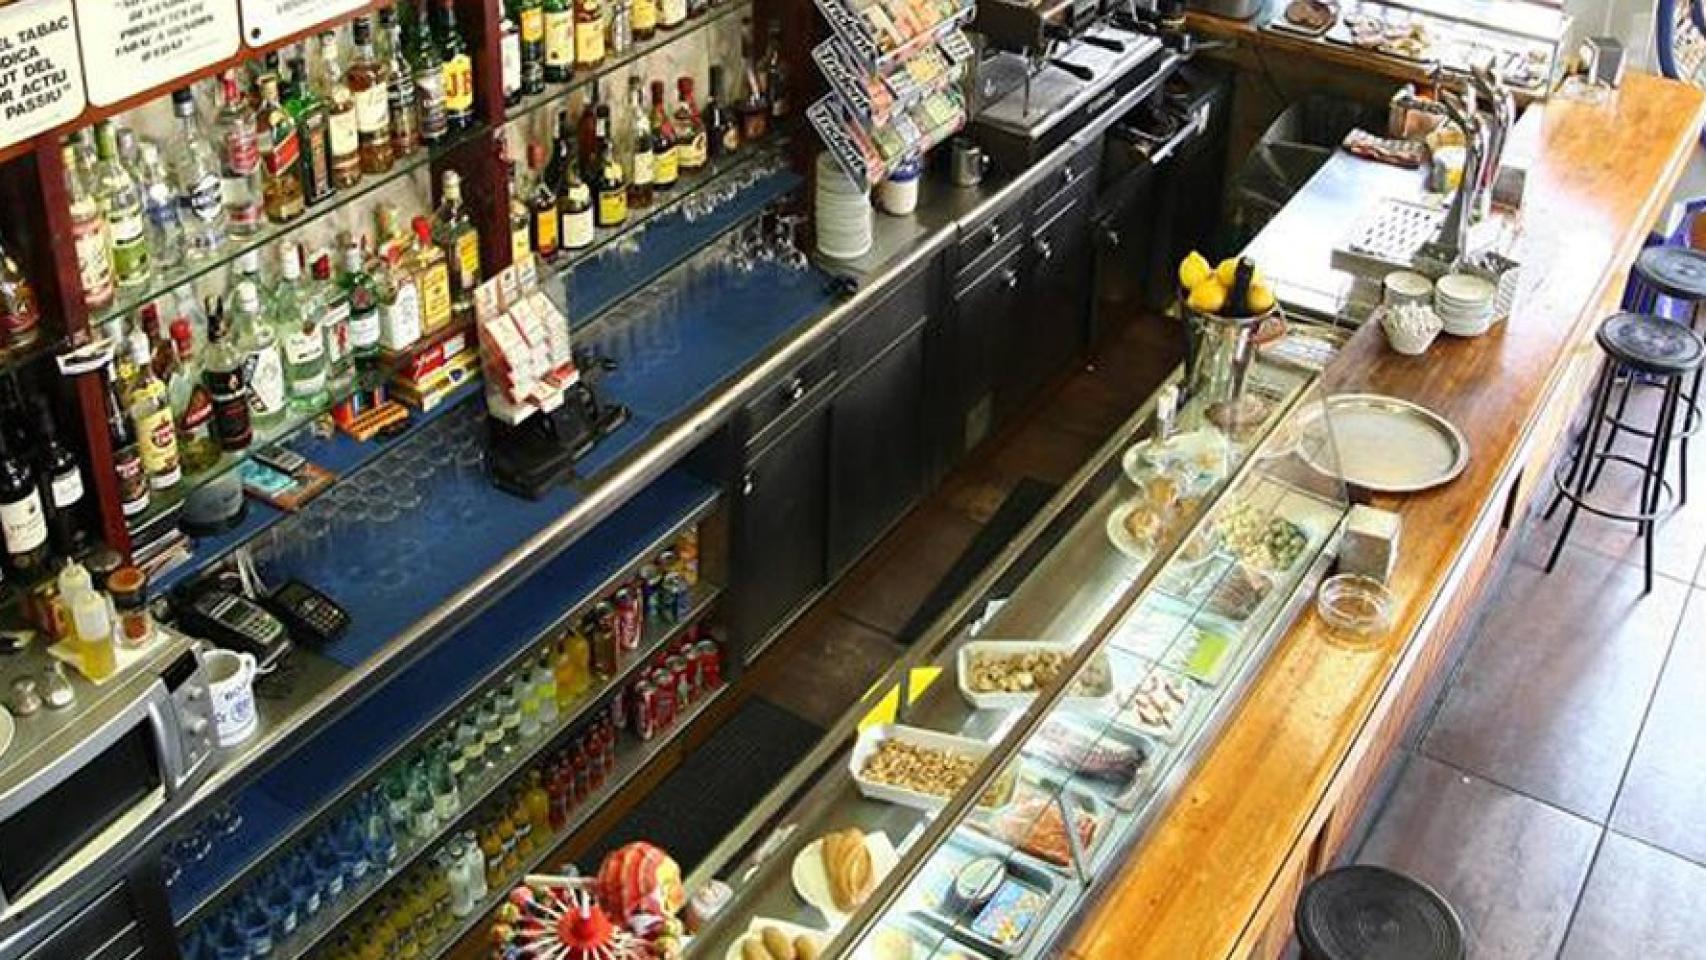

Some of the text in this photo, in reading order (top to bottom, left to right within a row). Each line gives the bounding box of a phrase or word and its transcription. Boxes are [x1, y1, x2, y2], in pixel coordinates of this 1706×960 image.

[17, 15, 69, 43] TABAC
[23, 58, 55, 77] DEL
[21, 69, 67, 97] ACTIU
